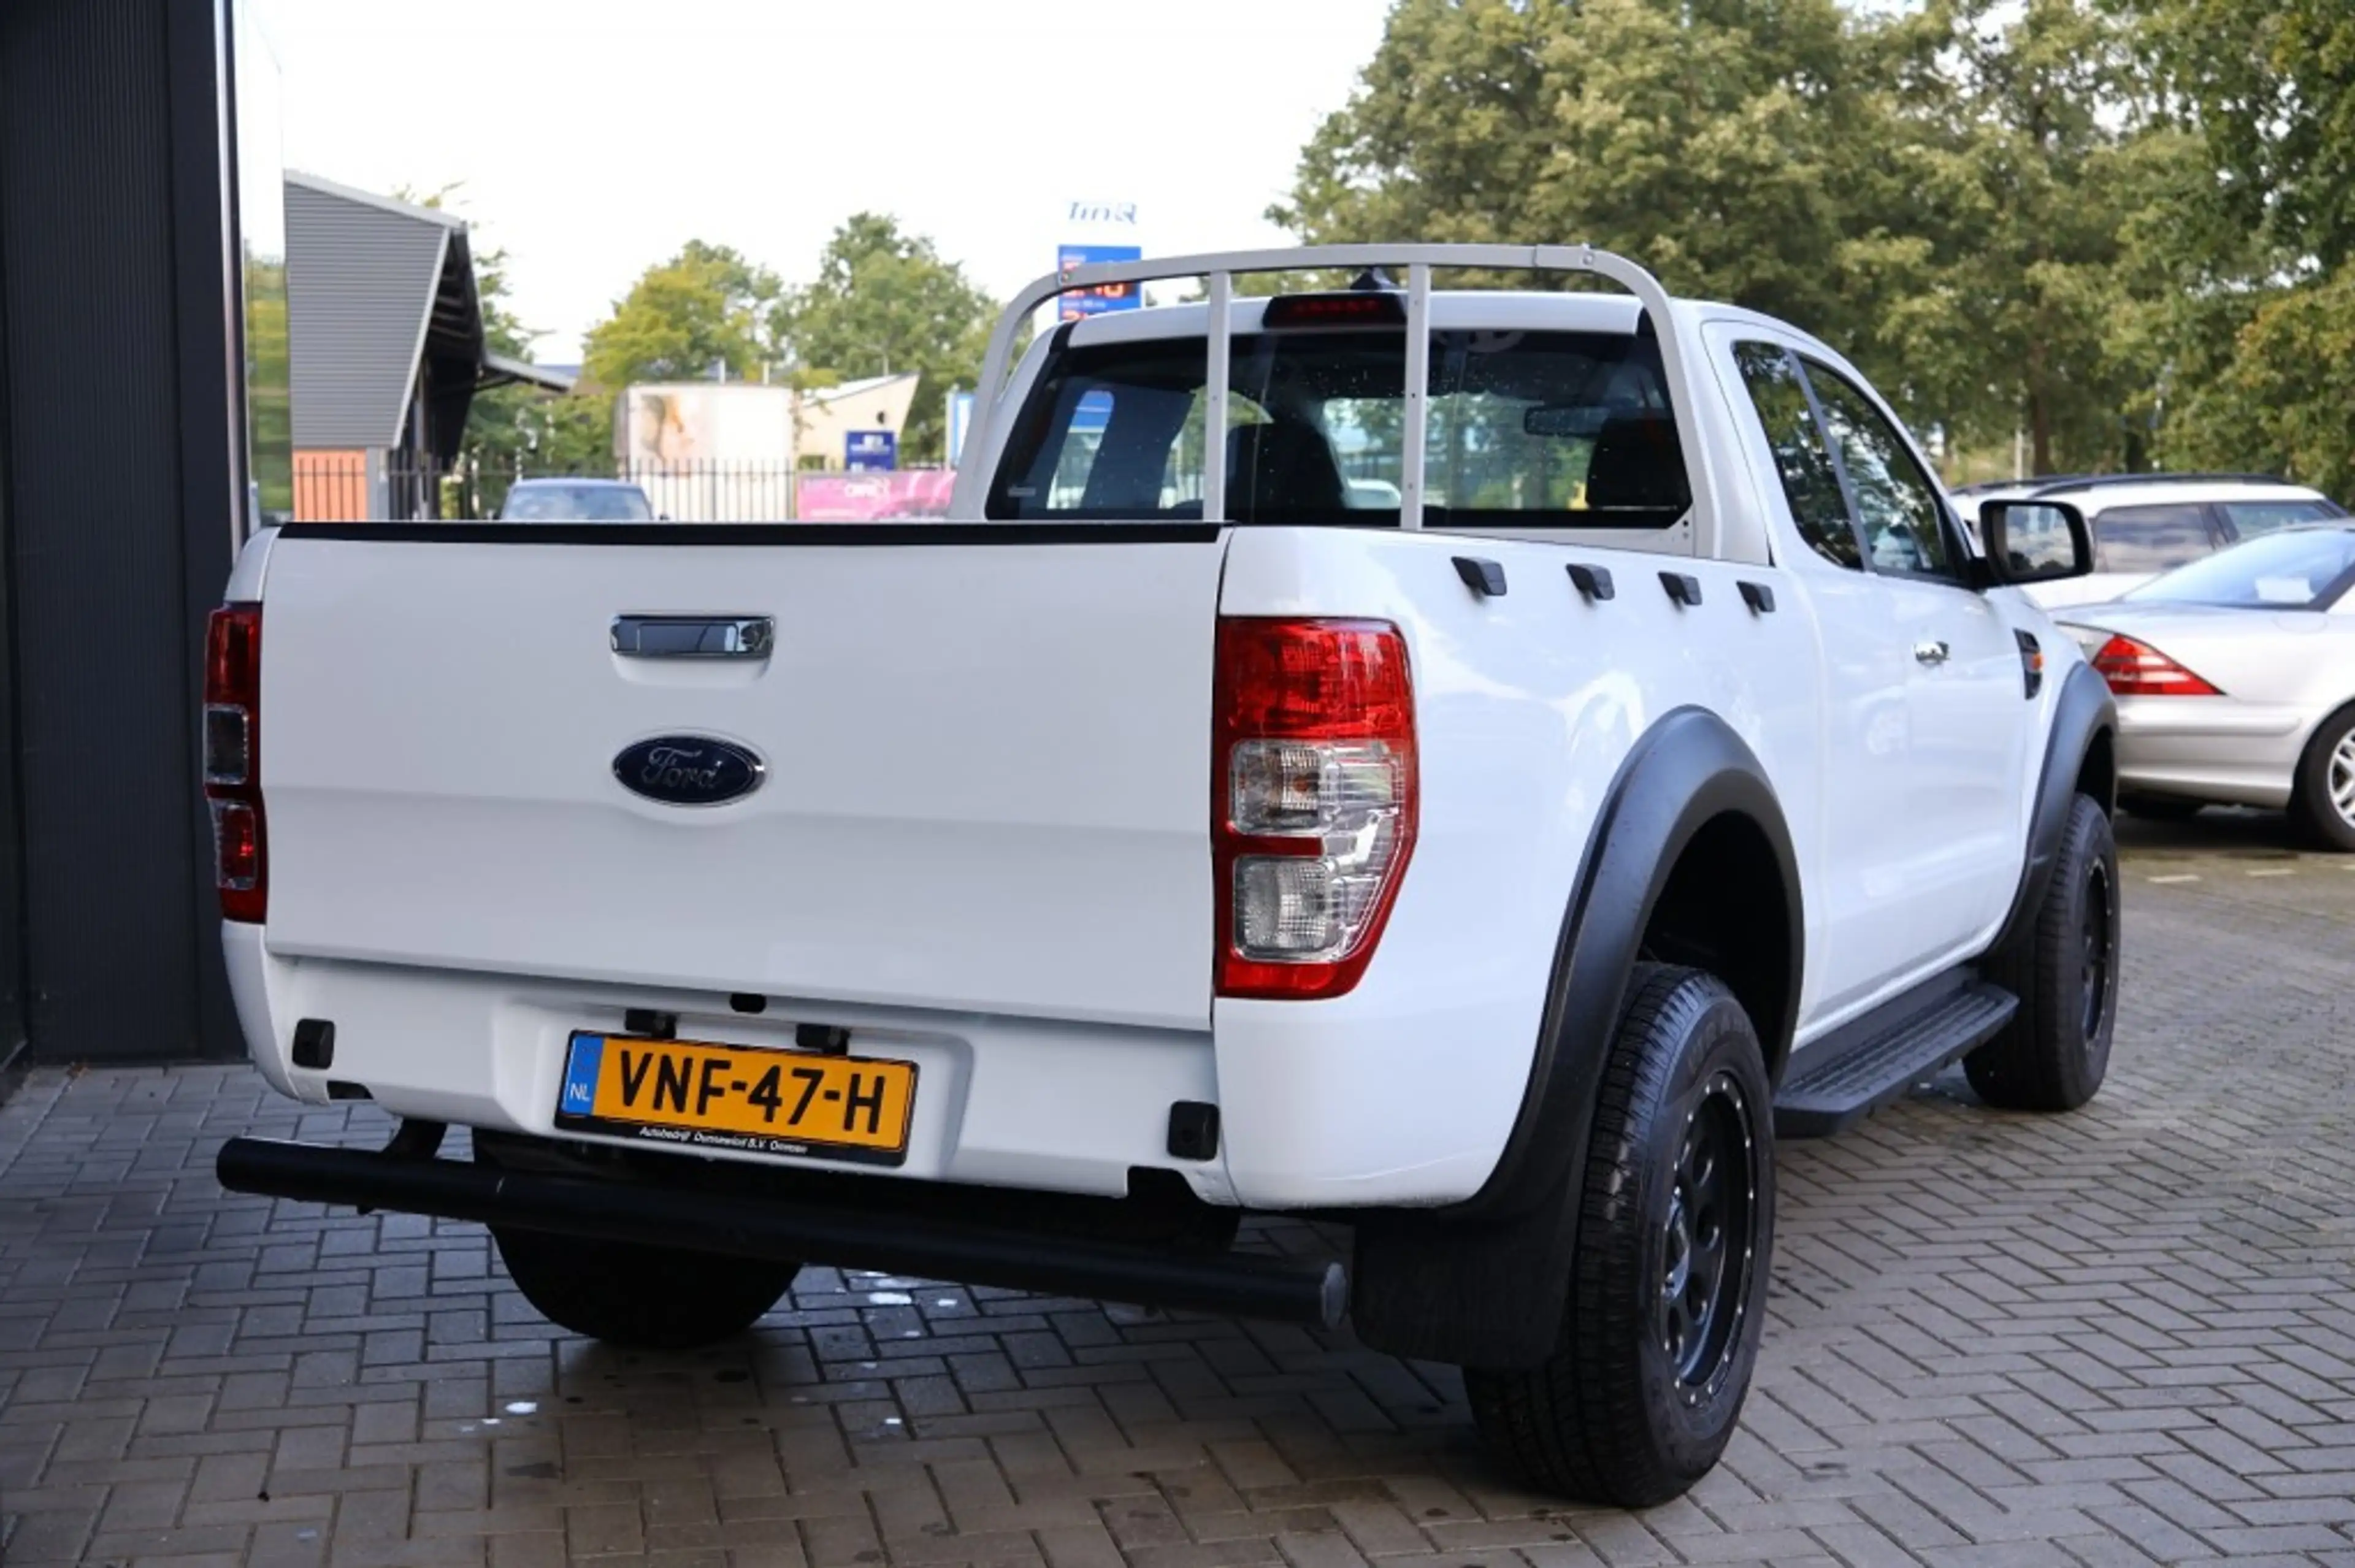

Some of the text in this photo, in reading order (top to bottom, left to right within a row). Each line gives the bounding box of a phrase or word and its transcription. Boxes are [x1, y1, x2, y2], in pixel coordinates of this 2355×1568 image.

[641, 746, 723, 789] Ford
[570, 1082, 591, 1102] NL
[621, 1050, 885, 1134] VNF-47-H
